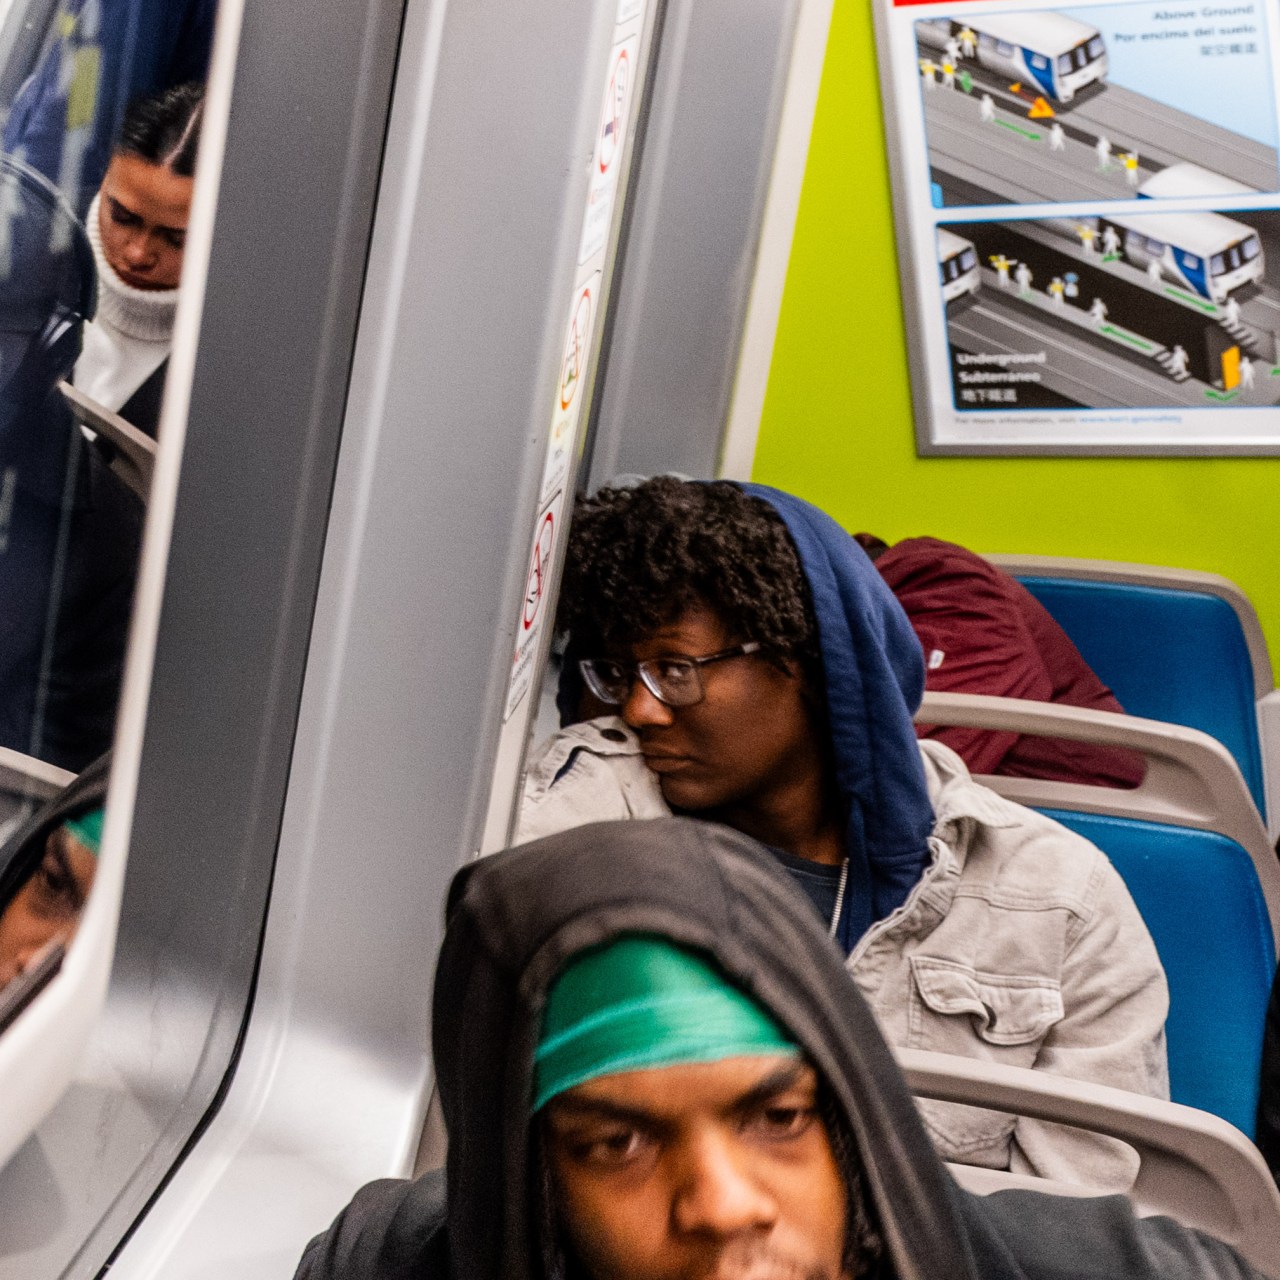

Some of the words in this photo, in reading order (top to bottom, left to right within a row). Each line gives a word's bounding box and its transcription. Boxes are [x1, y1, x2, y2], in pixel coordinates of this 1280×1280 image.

[1153, 11, 1196, 21] Above
[1201, 5, 1254, 17] Ground
[956, 351, 1046, 367] Underground
